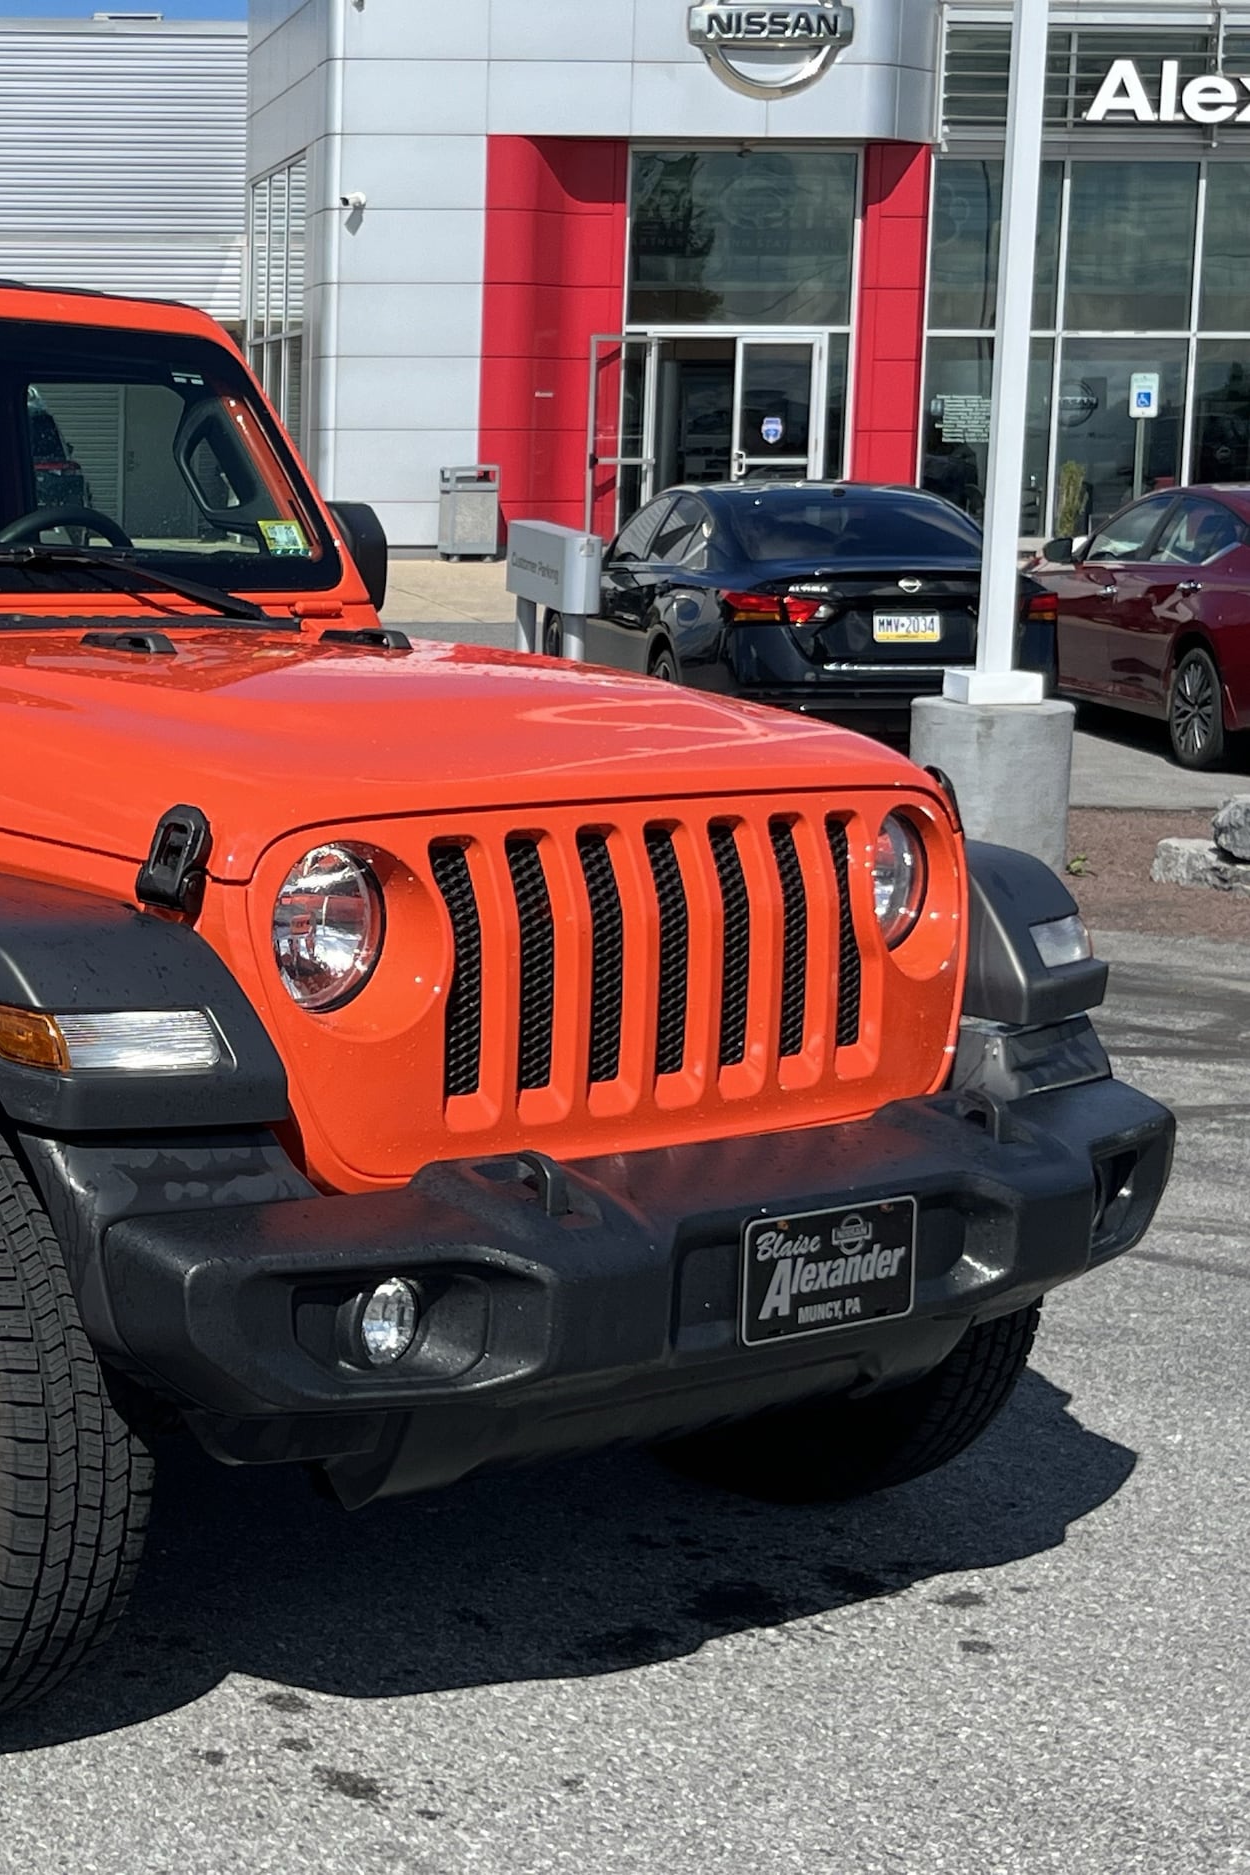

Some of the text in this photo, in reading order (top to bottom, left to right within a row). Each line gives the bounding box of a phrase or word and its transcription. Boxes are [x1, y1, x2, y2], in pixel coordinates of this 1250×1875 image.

[706, 11, 840, 38] NISSAN
[1086, 59, 1250, 123] Ale
[755, 1231, 821, 1262] Blaise
[758, 1243, 906, 1321] Alexander
[797, 1296, 862, 1325] MUNCY, PA
